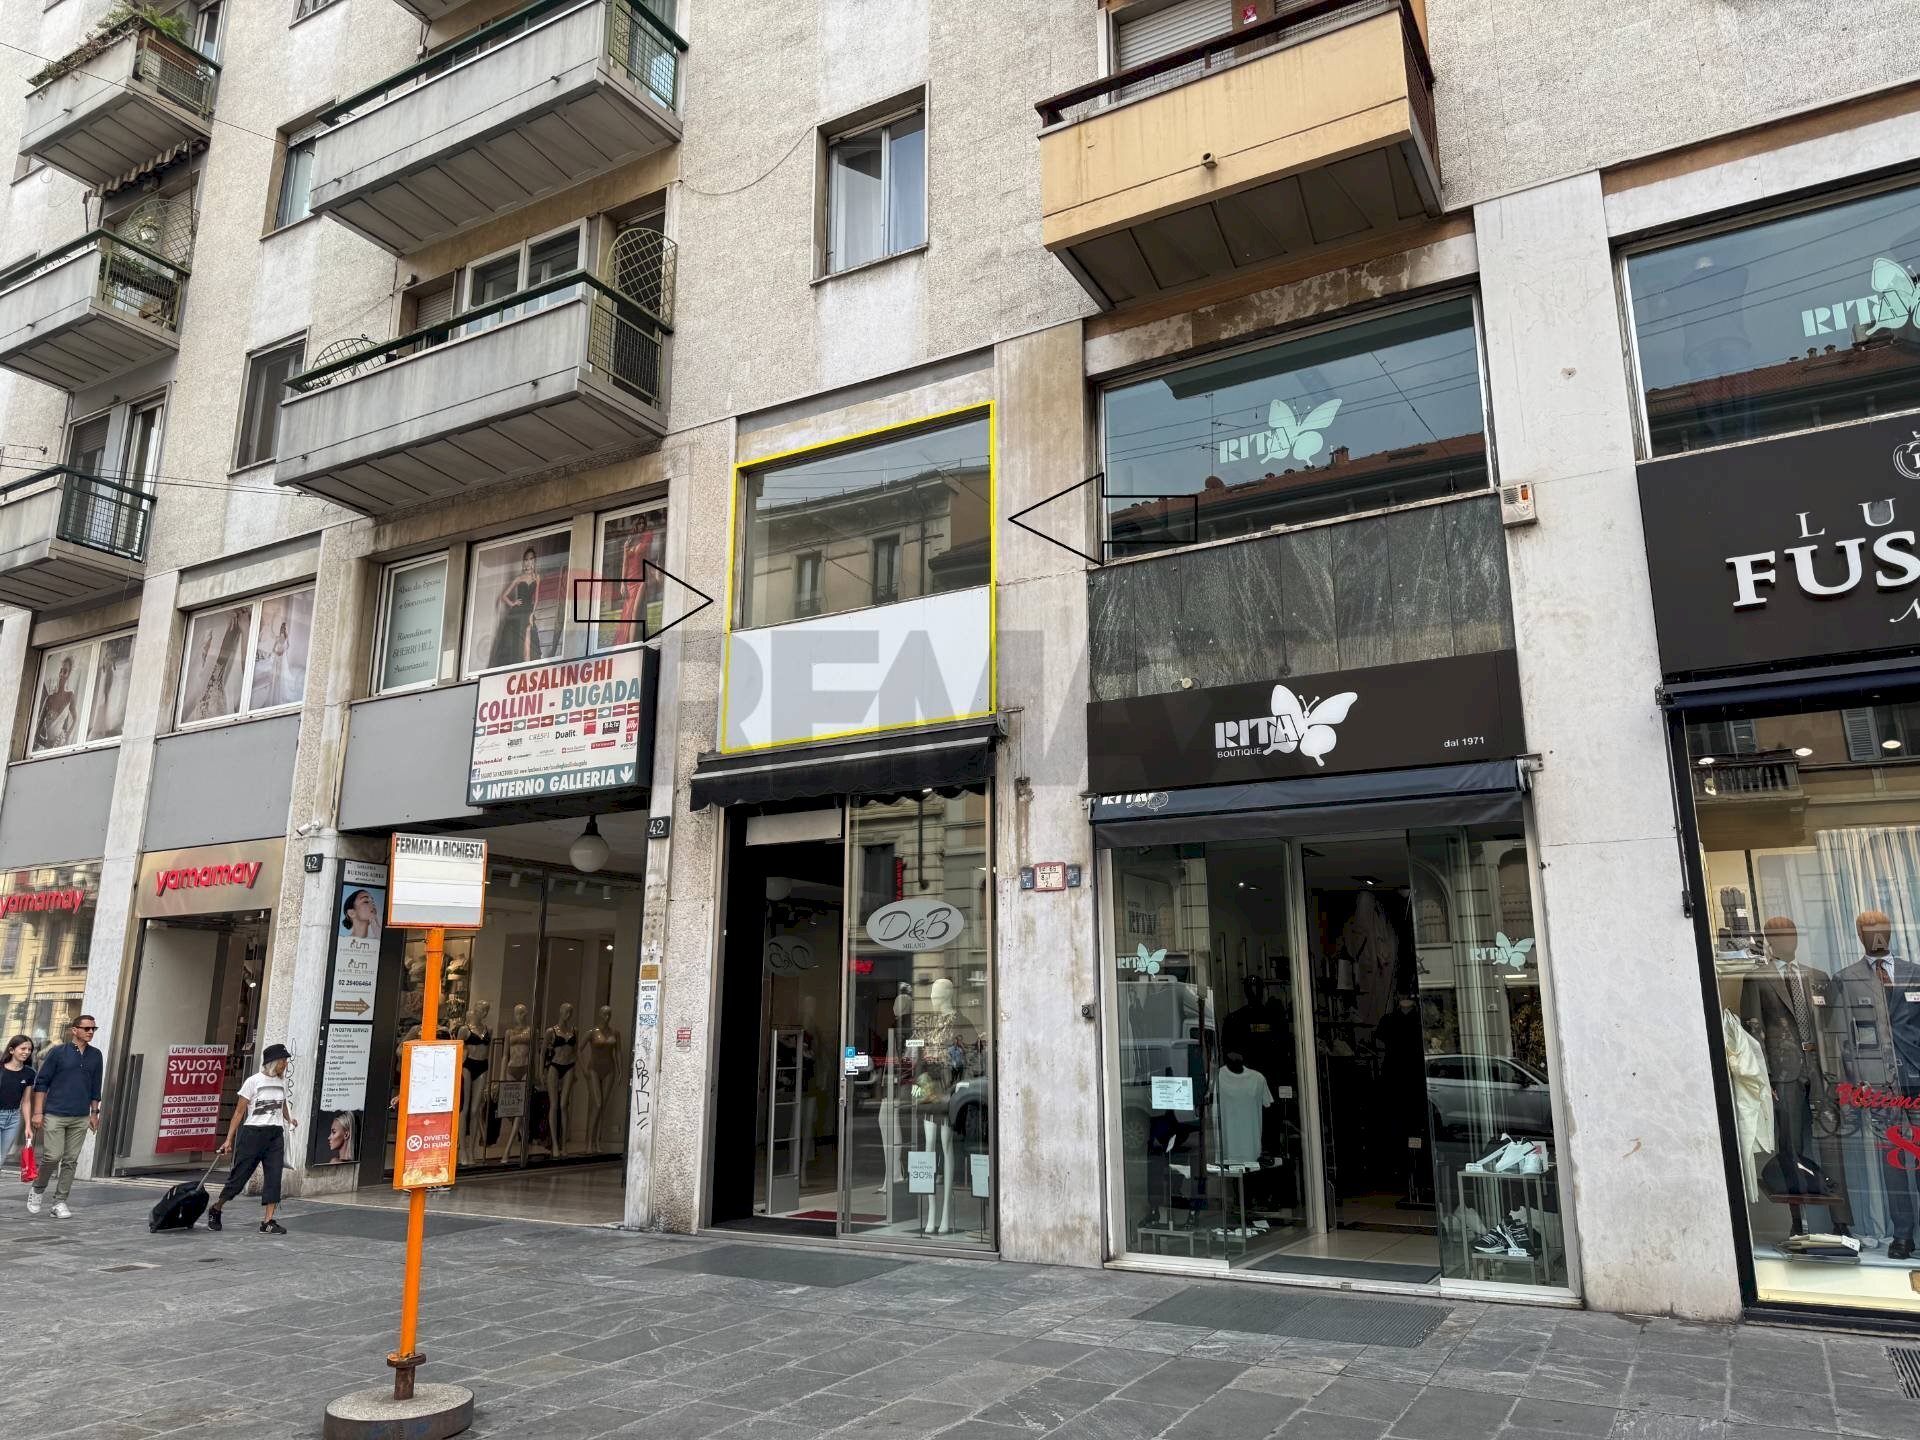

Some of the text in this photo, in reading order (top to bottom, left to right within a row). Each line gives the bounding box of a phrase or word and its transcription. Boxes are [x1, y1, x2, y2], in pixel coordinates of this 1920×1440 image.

[1801, 290, 1910, 337] RITA
[1219, 427, 1291, 464] RITA
[506, 658, 613, 695] CASALINGHI
[478, 692, 543, 722] COLLINI
[561, 677, 640, 711] BUGADA
[555, 729, 576, 739] Dualit
[1214, 714, 1300, 749] RITA
[1443, 736, 1485, 748] dal 1971
[1217, 747, 1262, 759] BOUTIQUE
[486, 778, 545, 800] INTERNO
[549, 768, 616, 791] GALLERIA
[649, 819, 665, 835] 42
[395, 837, 484, 859] FERMATA A RICHIESTA
[304, 856, 318, 870] 42
[155, 862, 263, 896] yamamay
[0, 889, 84, 919] yamamay
[878, 907, 952, 941] D&B
[1117, 957, 1147, 969] RITA
[1470, 947, 1509, 962] RITA
[198, 1046, 225, 1054] GIORNI
[168, 1060, 222, 1071] SVUOTA
[170, 1073, 218, 1085] TUTTO
